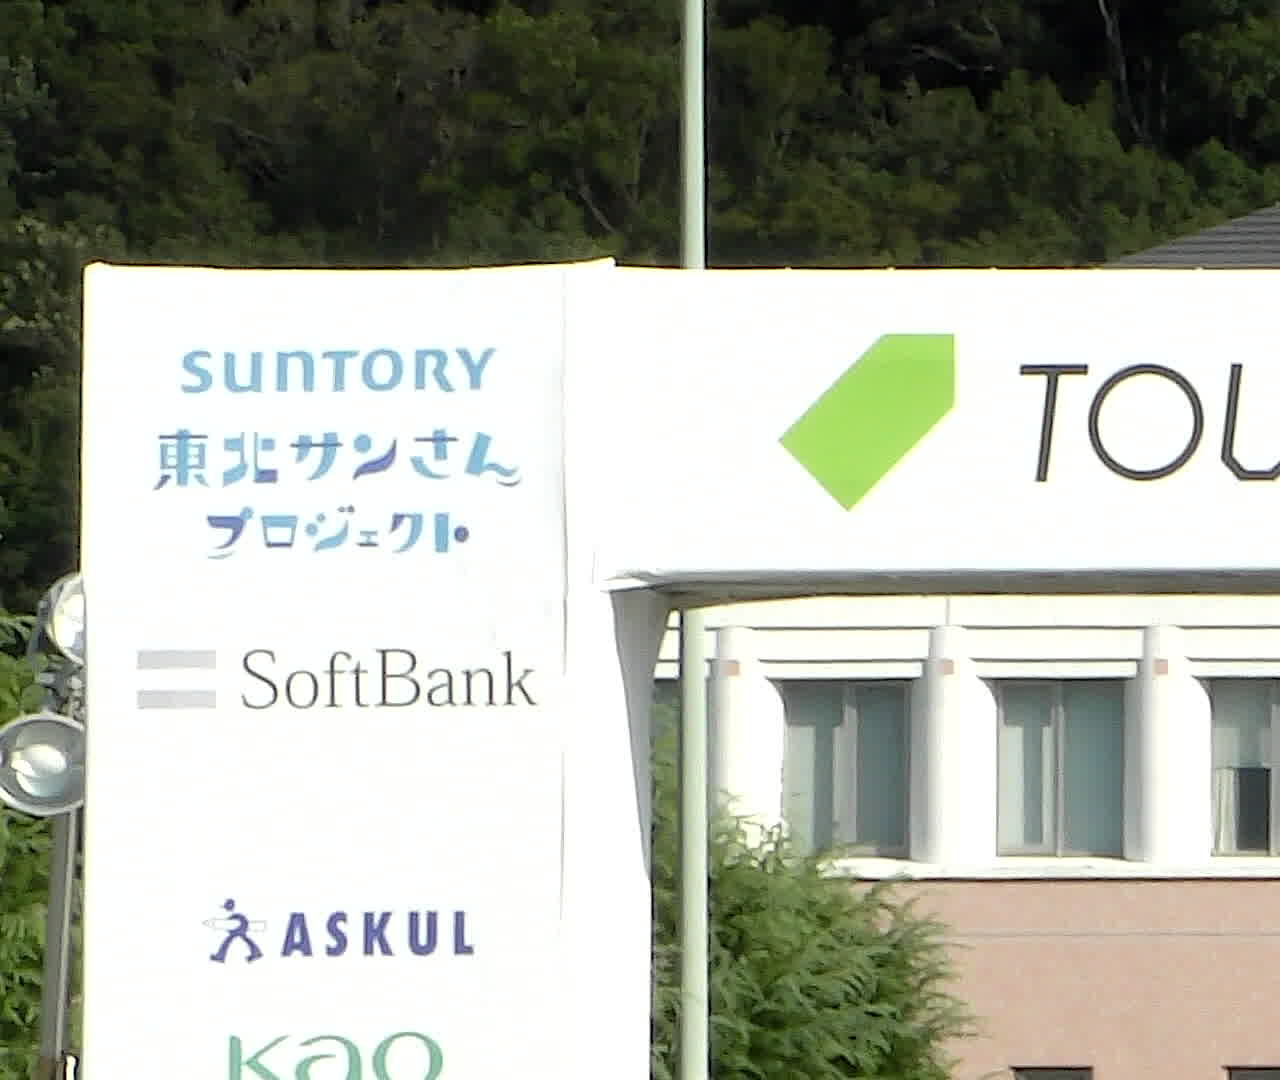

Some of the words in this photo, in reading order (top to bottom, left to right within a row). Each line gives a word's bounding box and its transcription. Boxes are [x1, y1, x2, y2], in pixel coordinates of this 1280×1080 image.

[180, 347, 497, 394] SUNTORY
[153, 428, 521, 490] 東北サンさん
[206, 505, 470, 560] プロジェクト
[241, 648, 539, 711] SoftBank
[281, 910, 475, 957] ASKUL
